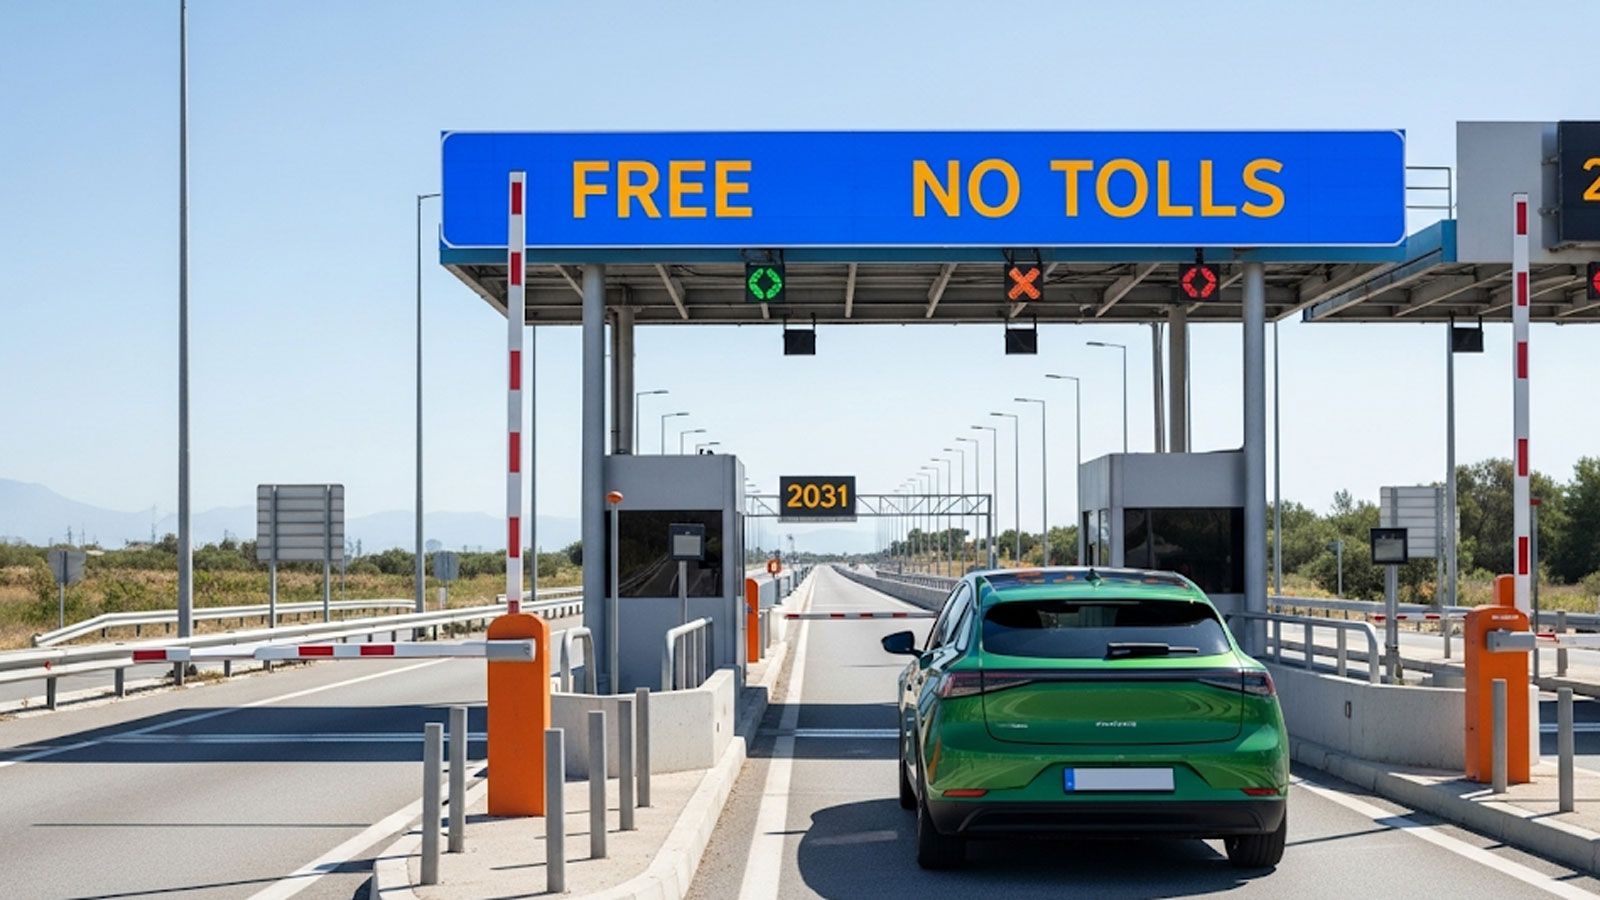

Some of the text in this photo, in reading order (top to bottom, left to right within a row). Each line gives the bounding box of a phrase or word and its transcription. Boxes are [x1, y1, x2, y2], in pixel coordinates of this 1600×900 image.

[572, 158, 1285, 218] FREE NO TOLLS
[786, 484, 848, 508] 2031
